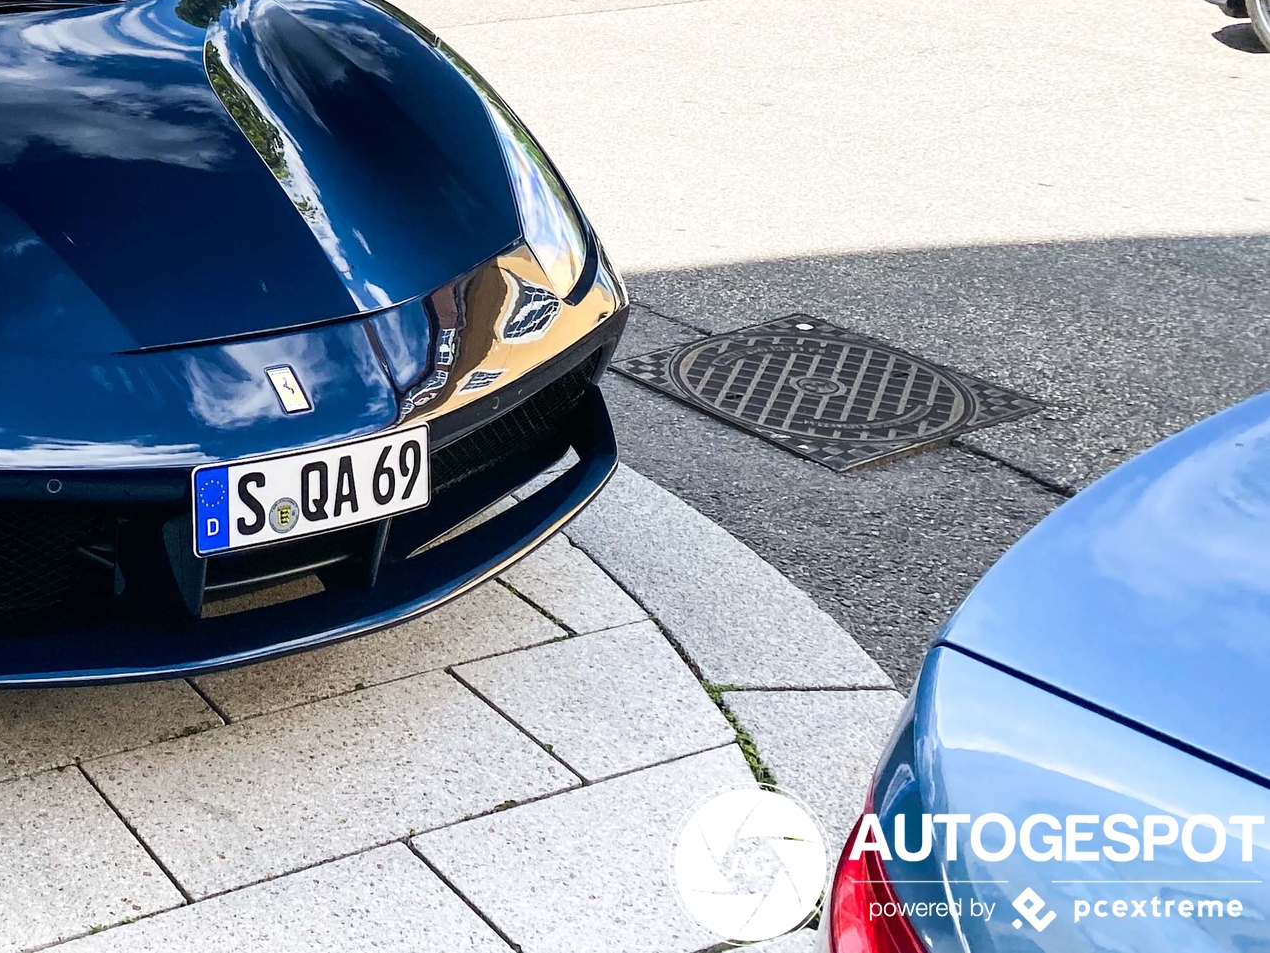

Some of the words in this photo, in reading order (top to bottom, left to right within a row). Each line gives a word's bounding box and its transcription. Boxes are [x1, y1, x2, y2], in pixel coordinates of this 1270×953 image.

[207, 517, 220, 536] D
[237, 471, 266, 536] S
[300, 460, 359, 522] QA
[372, 439, 422, 506] 69
